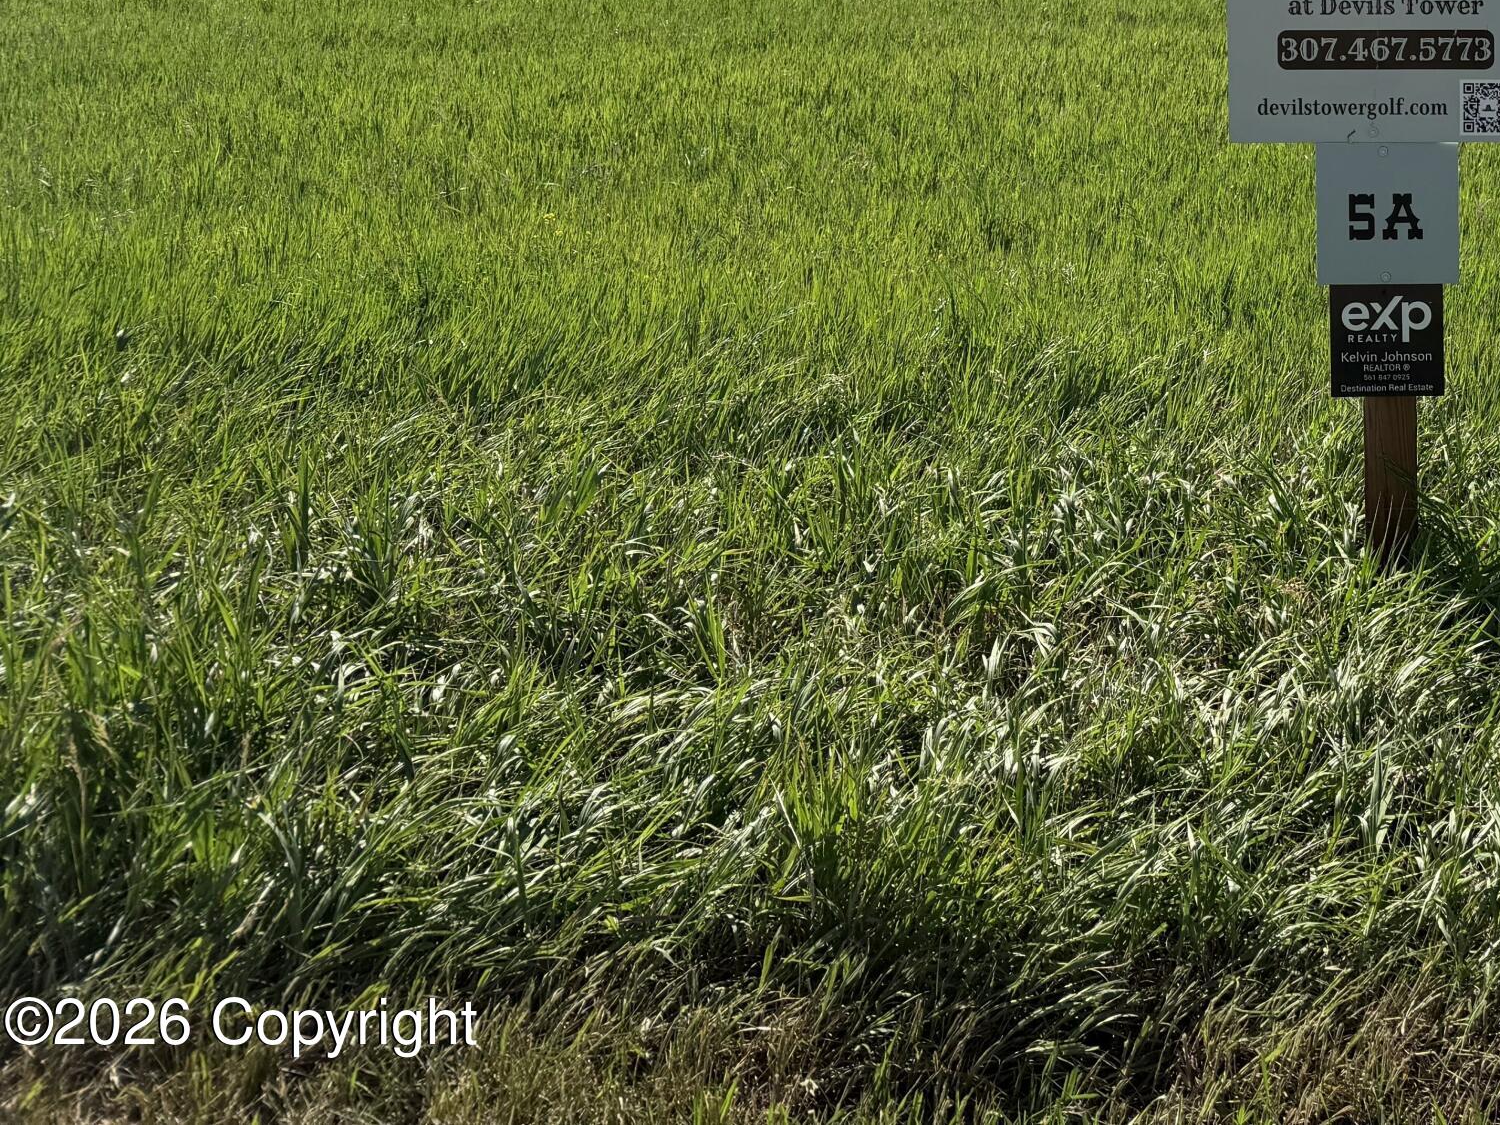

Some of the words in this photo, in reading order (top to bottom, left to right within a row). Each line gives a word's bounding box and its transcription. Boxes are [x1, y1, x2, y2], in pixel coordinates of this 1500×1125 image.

[1280, 36, 1492, 62] 307.467.5773
[1258, 98, 1448, 120] devilstowergolf.com
[1349, 194, 1423, 240] 5A
[1347, 333, 1398, 343] REALTY
[1341, 351, 1378, 363] Kelvin
[1381, 350, 1433, 362] Johnson
[1363, 363, 1401, 372] REALTOR
[1340, 384, 1387, 393] Destination
[1388, 383, 1407, 392] Real
[1408, 383, 1434, 391] Estate
